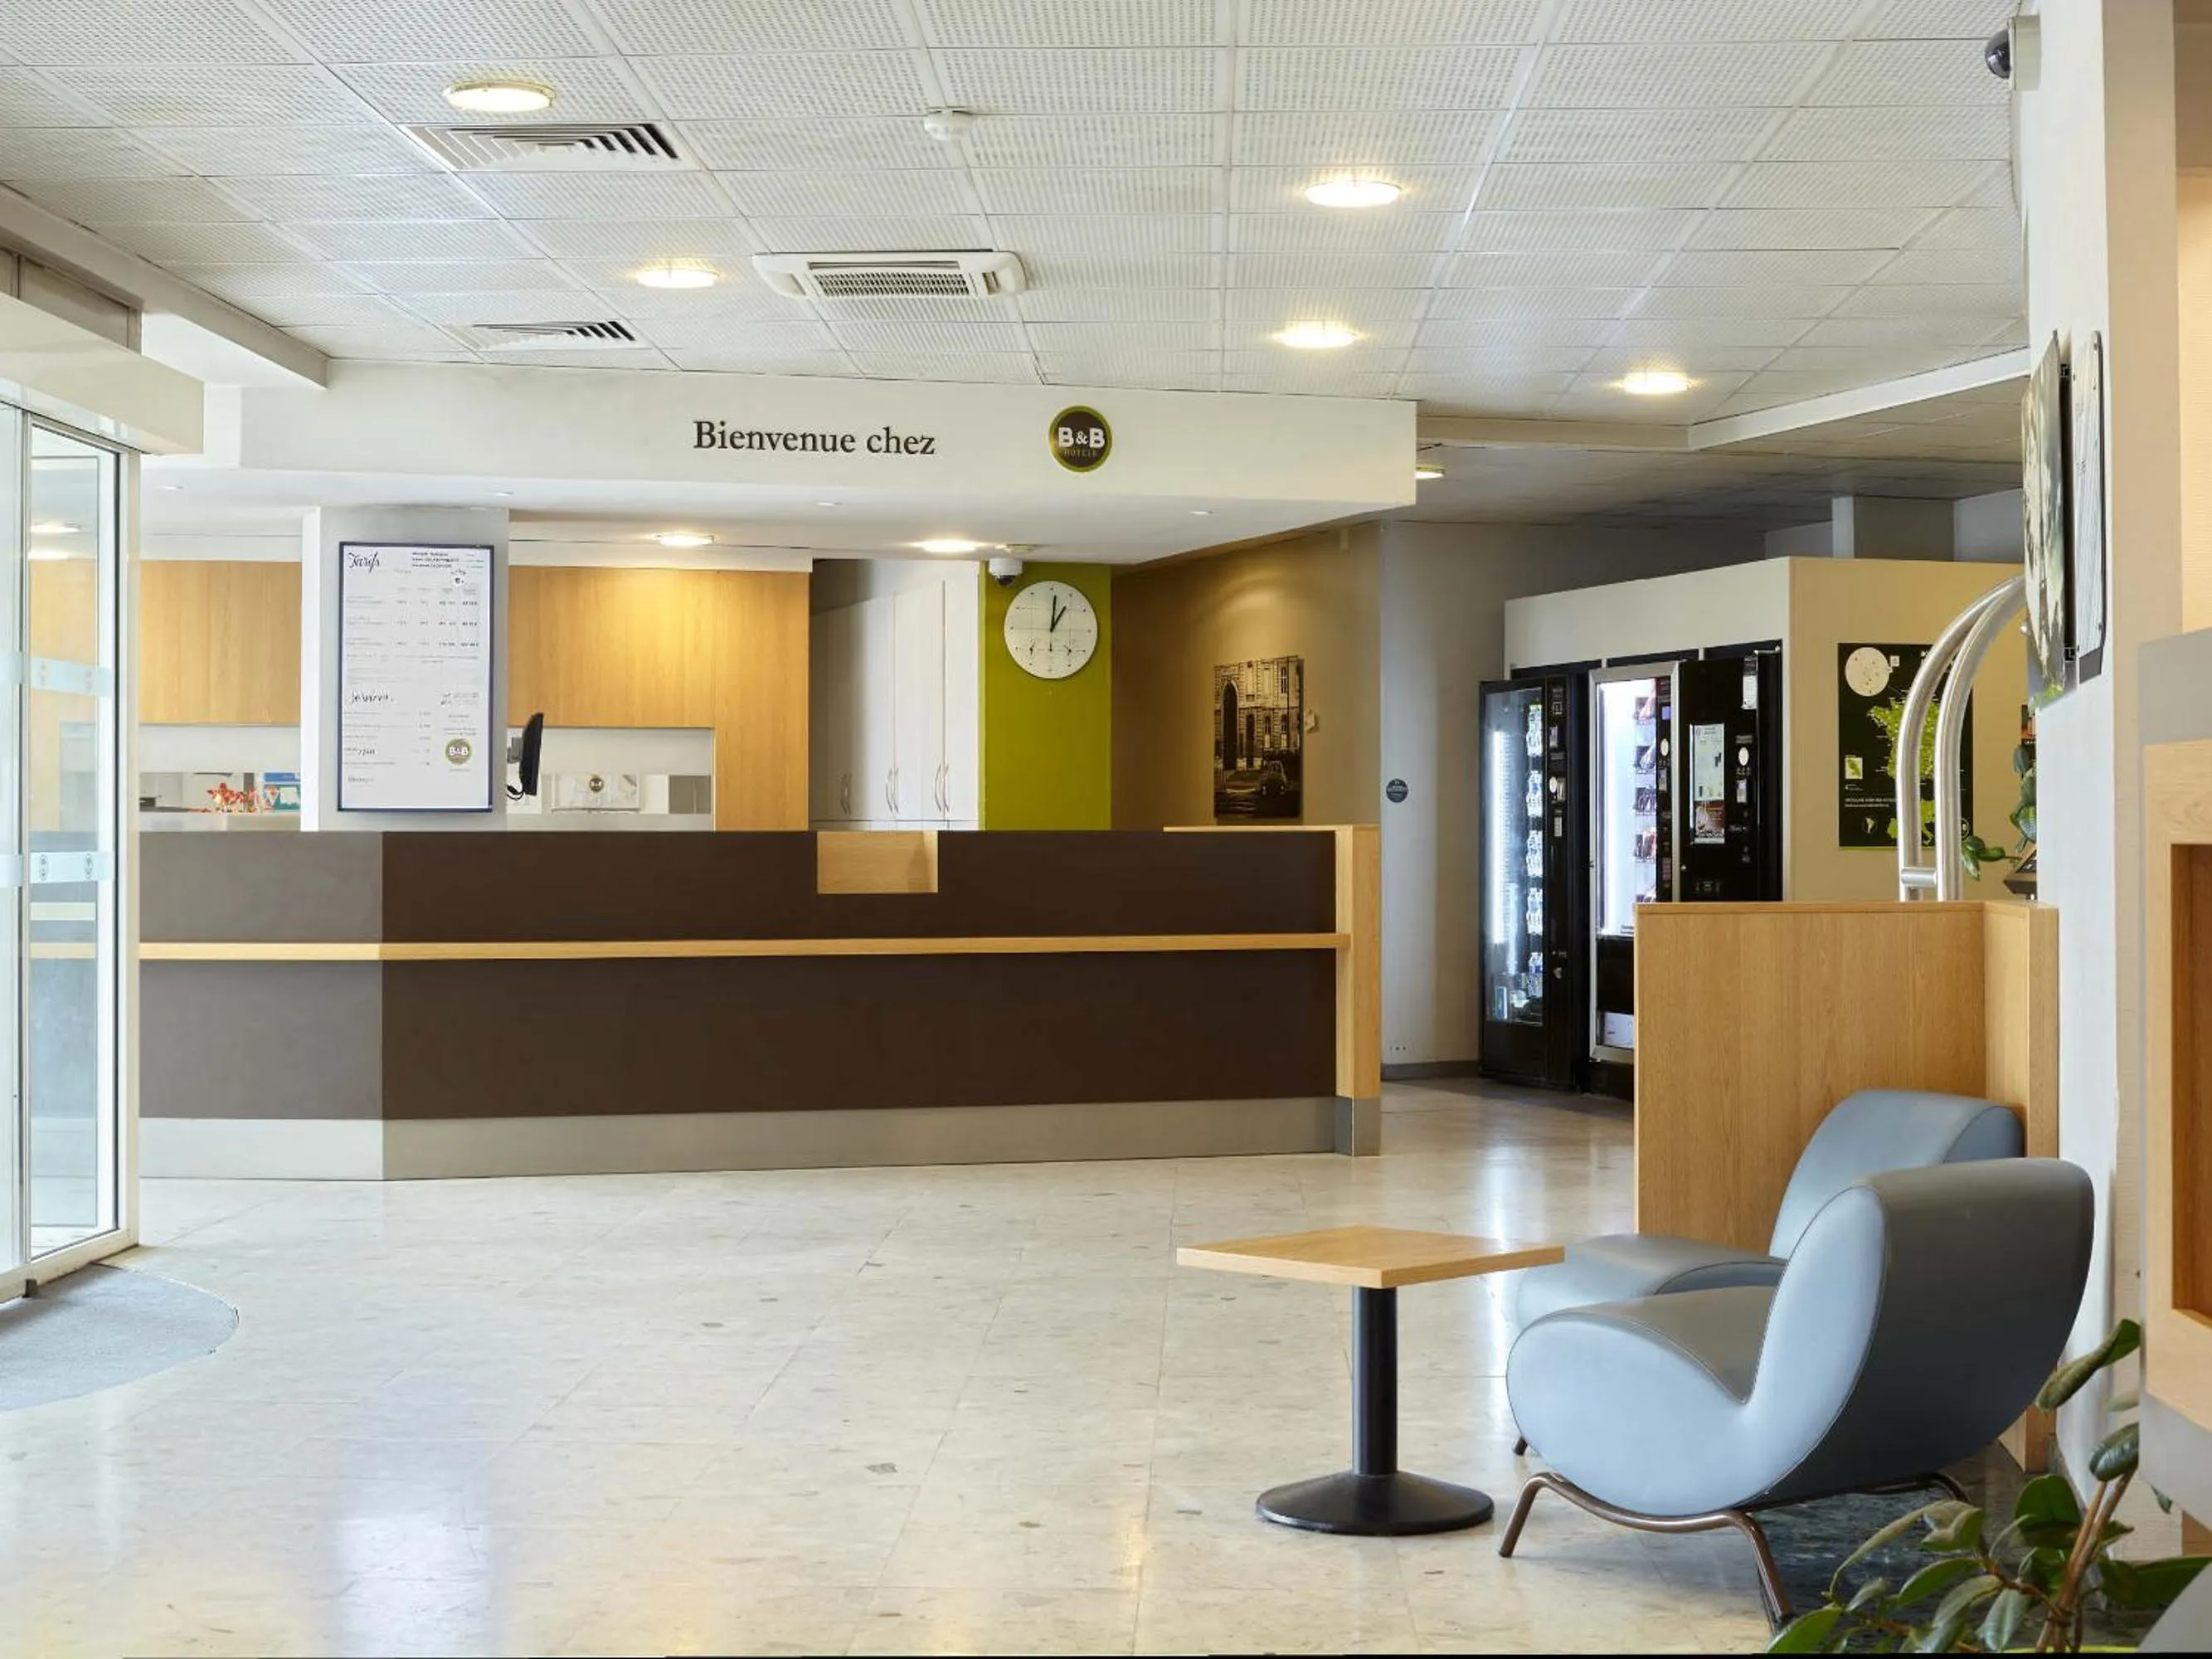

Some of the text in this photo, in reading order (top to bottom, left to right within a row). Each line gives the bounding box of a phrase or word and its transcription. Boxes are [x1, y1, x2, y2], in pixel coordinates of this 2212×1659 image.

[693, 421, 936, 455] Bienvenue chez
[1057, 426, 1106, 449] B&B
